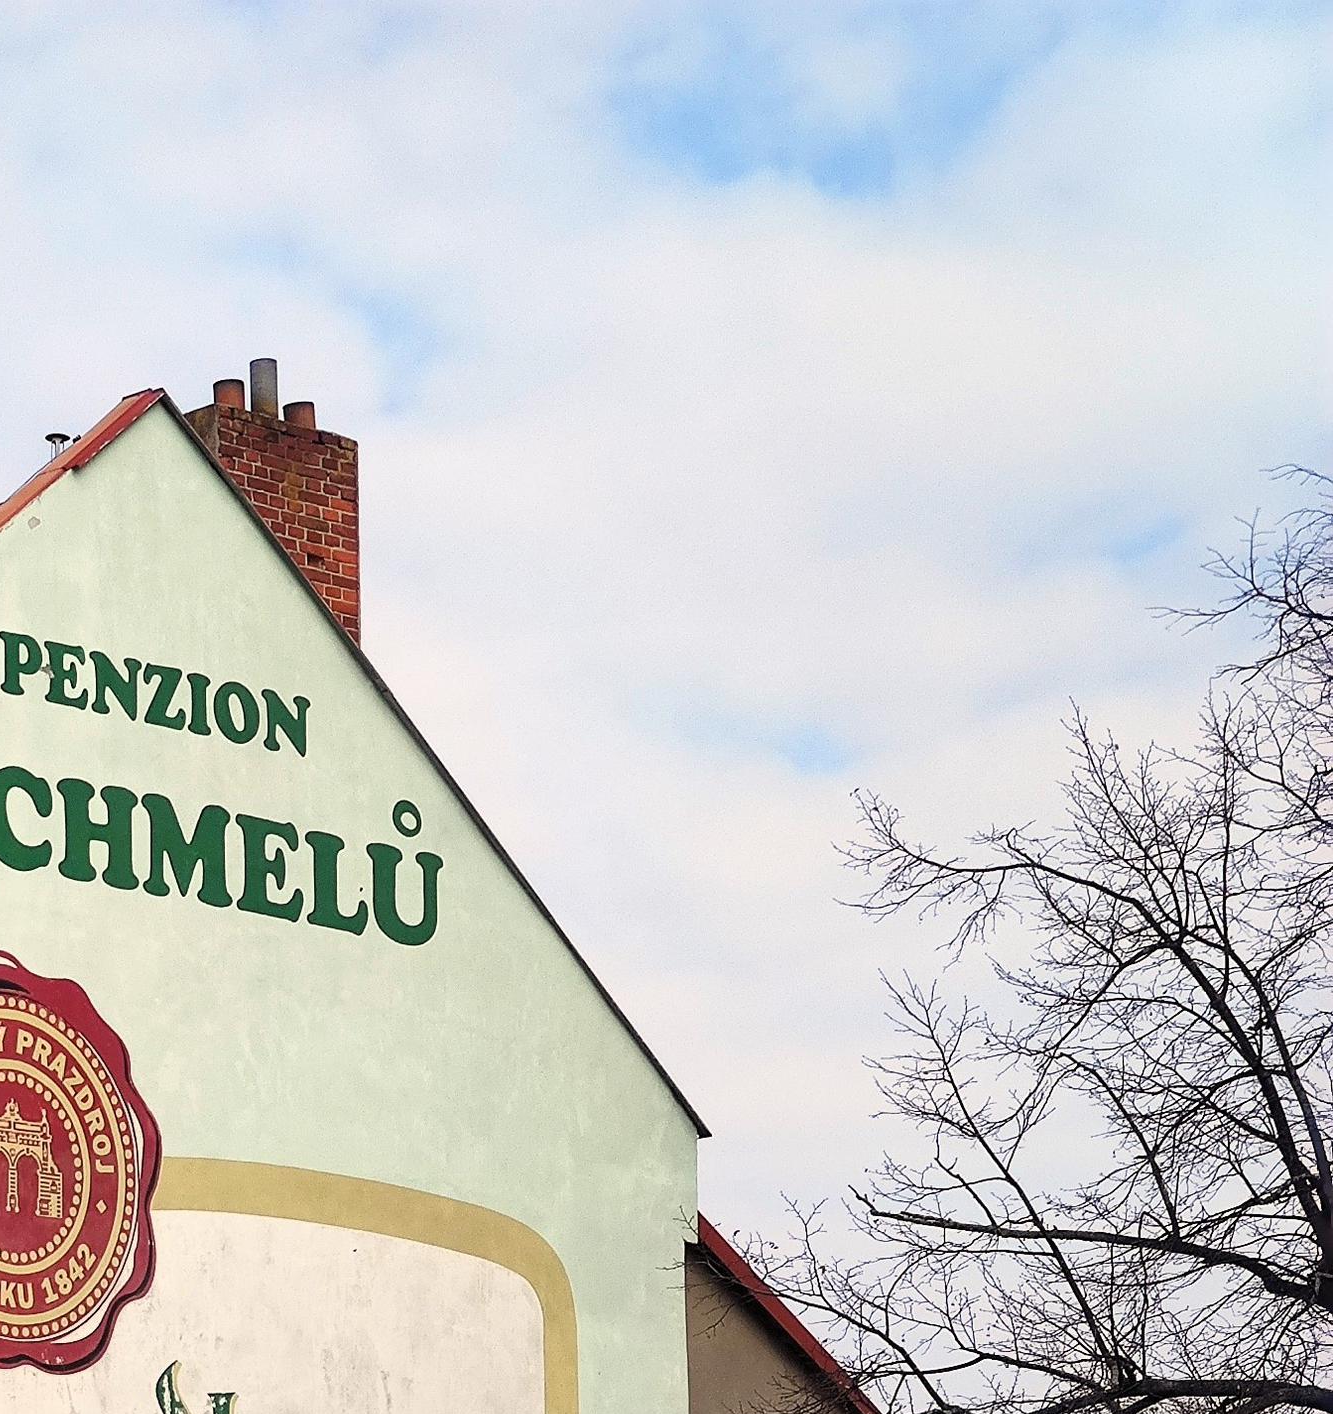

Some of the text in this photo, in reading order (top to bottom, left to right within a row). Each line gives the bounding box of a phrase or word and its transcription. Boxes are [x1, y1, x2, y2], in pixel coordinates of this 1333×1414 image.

[0, 631, 310, 757] PENZION
[15, 1027, 115, 1175] PRAZDROJ
[40, 1242, 98, 1304] 1842
